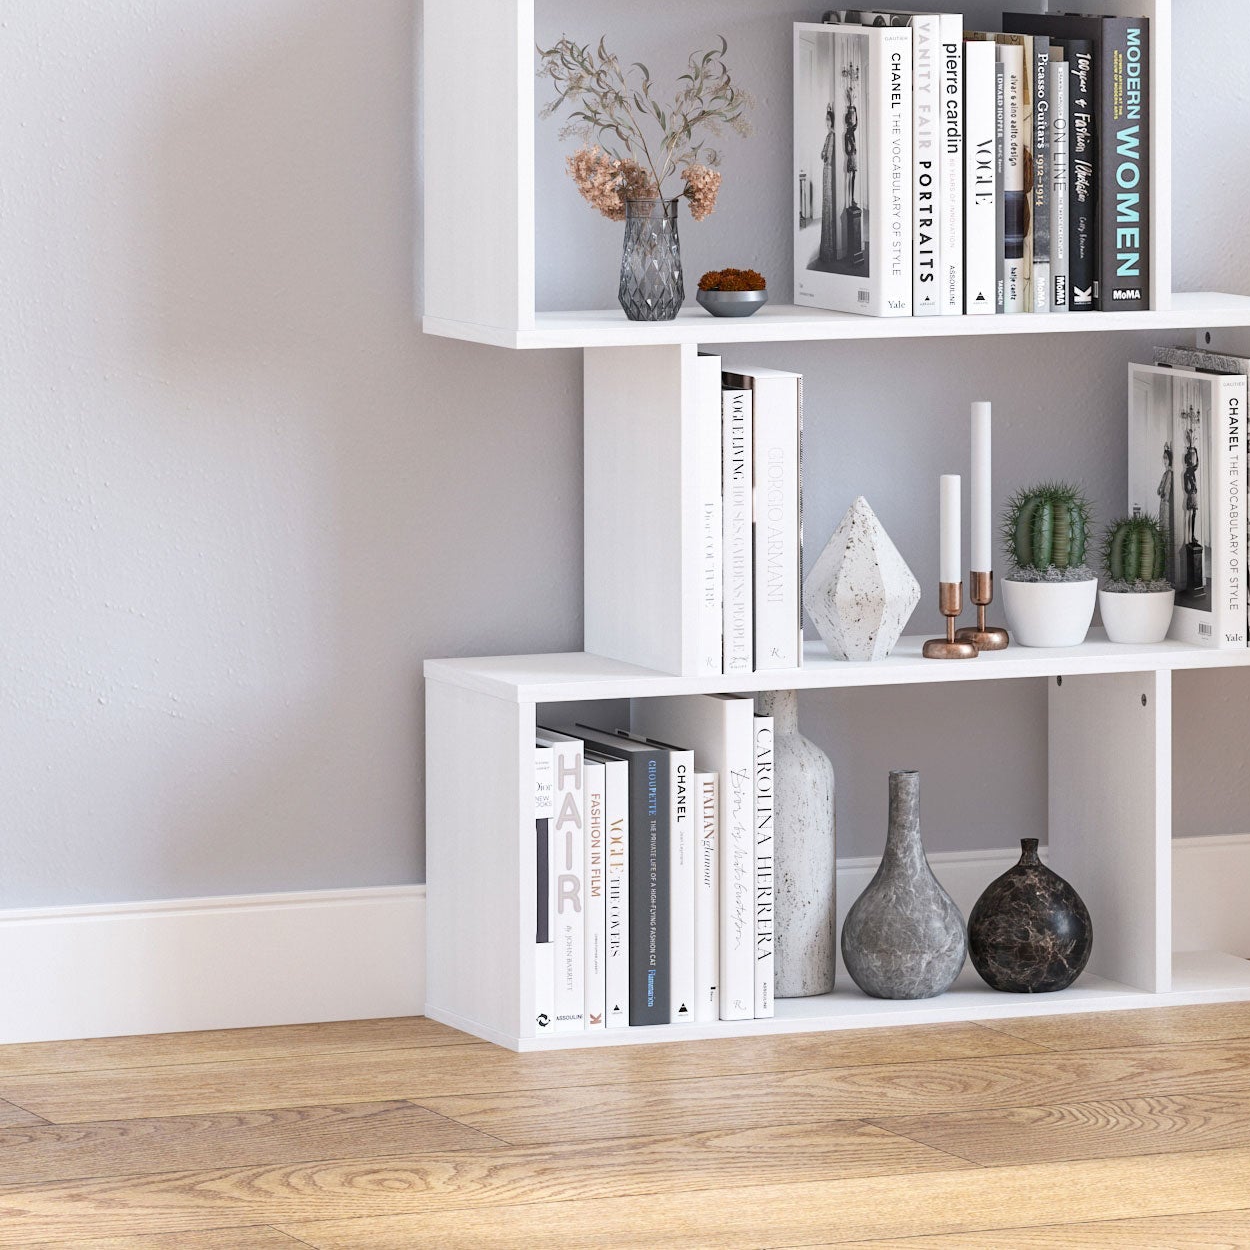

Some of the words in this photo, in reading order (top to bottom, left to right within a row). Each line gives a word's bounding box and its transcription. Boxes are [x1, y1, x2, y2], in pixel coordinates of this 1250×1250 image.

[918, 23, 931, 94] VANITY
[943, 43, 960, 94] pierre
[1038, 54, 1048, 98] Picasso
[1127, 28, 1140, 119] MODERN
[918, 105, 931, 149] FAIR
[947, 100, 961, 153] cardin
[1037, 101, 1048, 148] Guitars
[975, 139, 992, 205] VOGUE
[919, 161, 933, 283] PORTRAITS
[1116, 125, 1140, 276] WOMEN
[1113, 290, 1140, 300] MoMA
[1229, 398, 1239, 451] CHANEL
[1230, 455, 1238, 476] THE
[1230, 480, 1238, 555] VOCABULARY
[1230, 559, 1238, 572] OF
[1230, 577, 1238, 610] STYLE
[677, 765, 686, 822] CHANEL
[757, 728, 772, 845] CAROLINA
[556, 754, 581, 914] HAIR
[591, 794, 601, 848] FASHION
[591, 852, 601, 864] IN
[591, 869, 601, 897] FILM
[757, 856, 772, 961] HERRERA
